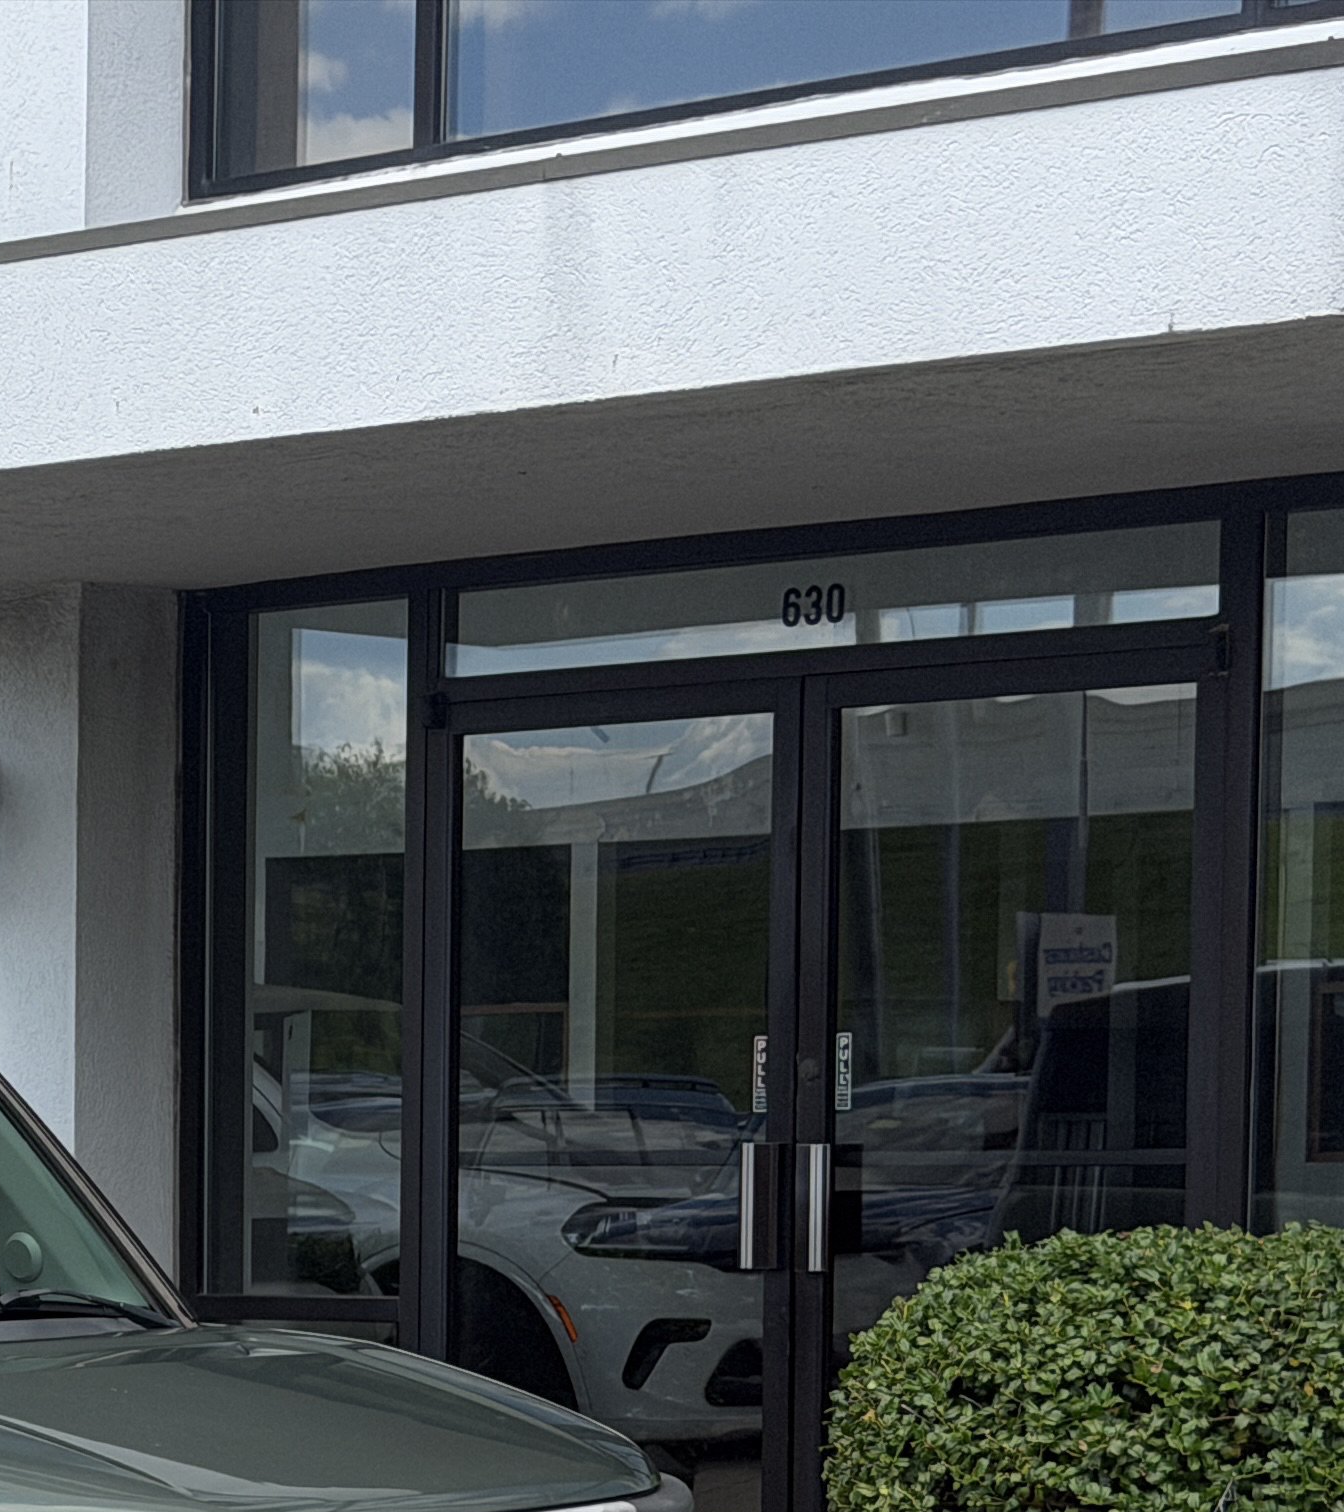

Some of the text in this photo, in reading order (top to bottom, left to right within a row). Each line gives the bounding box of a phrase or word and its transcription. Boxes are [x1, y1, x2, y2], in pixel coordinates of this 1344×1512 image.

[782, 583, 845, 627] 630
[756, 1040, 767, 1088] PULL
[839, 1037, 849, 1085] PULL
